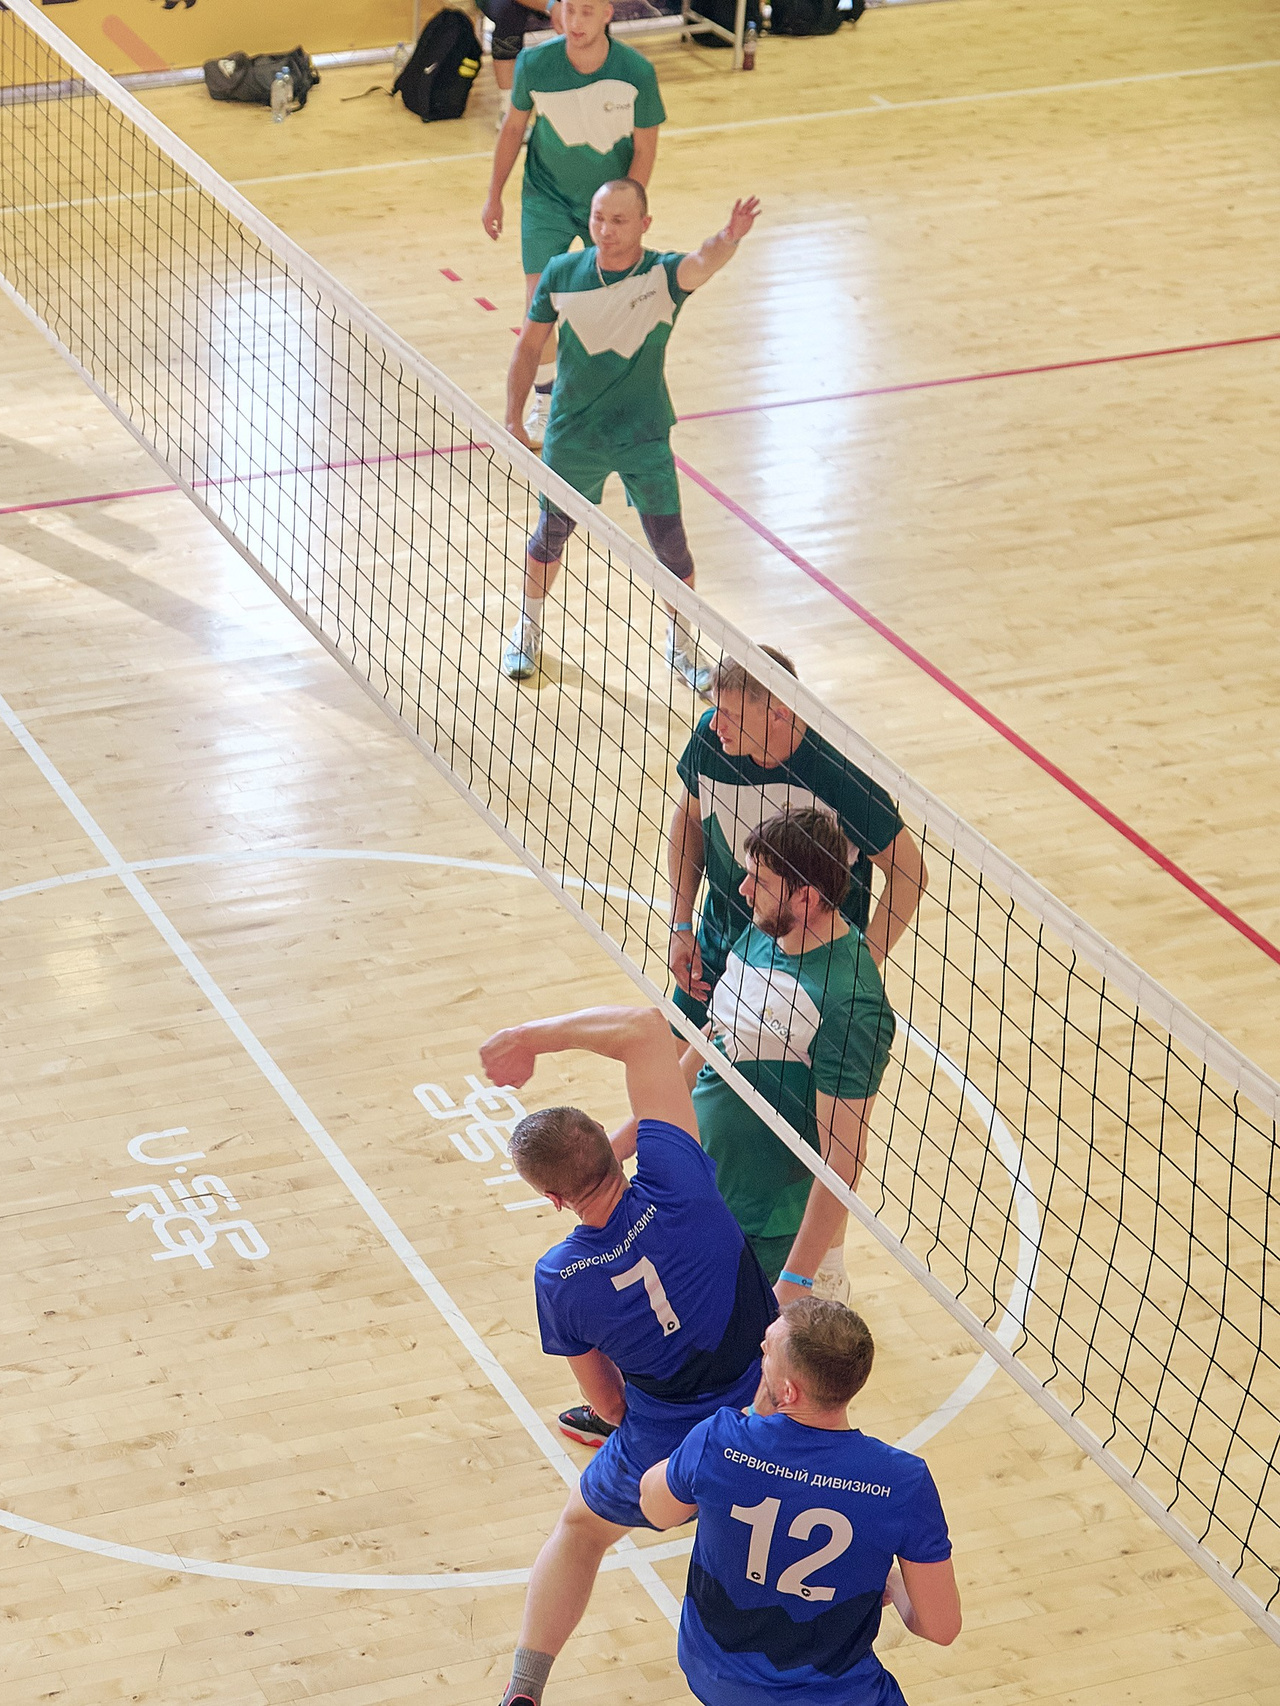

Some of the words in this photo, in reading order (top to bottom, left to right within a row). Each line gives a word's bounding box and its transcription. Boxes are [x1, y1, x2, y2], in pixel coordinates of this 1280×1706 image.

[610, 1255, 681, 1337] 7
[723, 1447, 809, 1483] СЕРВИСНЫЙ
[810, 1474, 891, 1498] ДИВИЗИОН
[730, 1496, 853, 1602] 12
